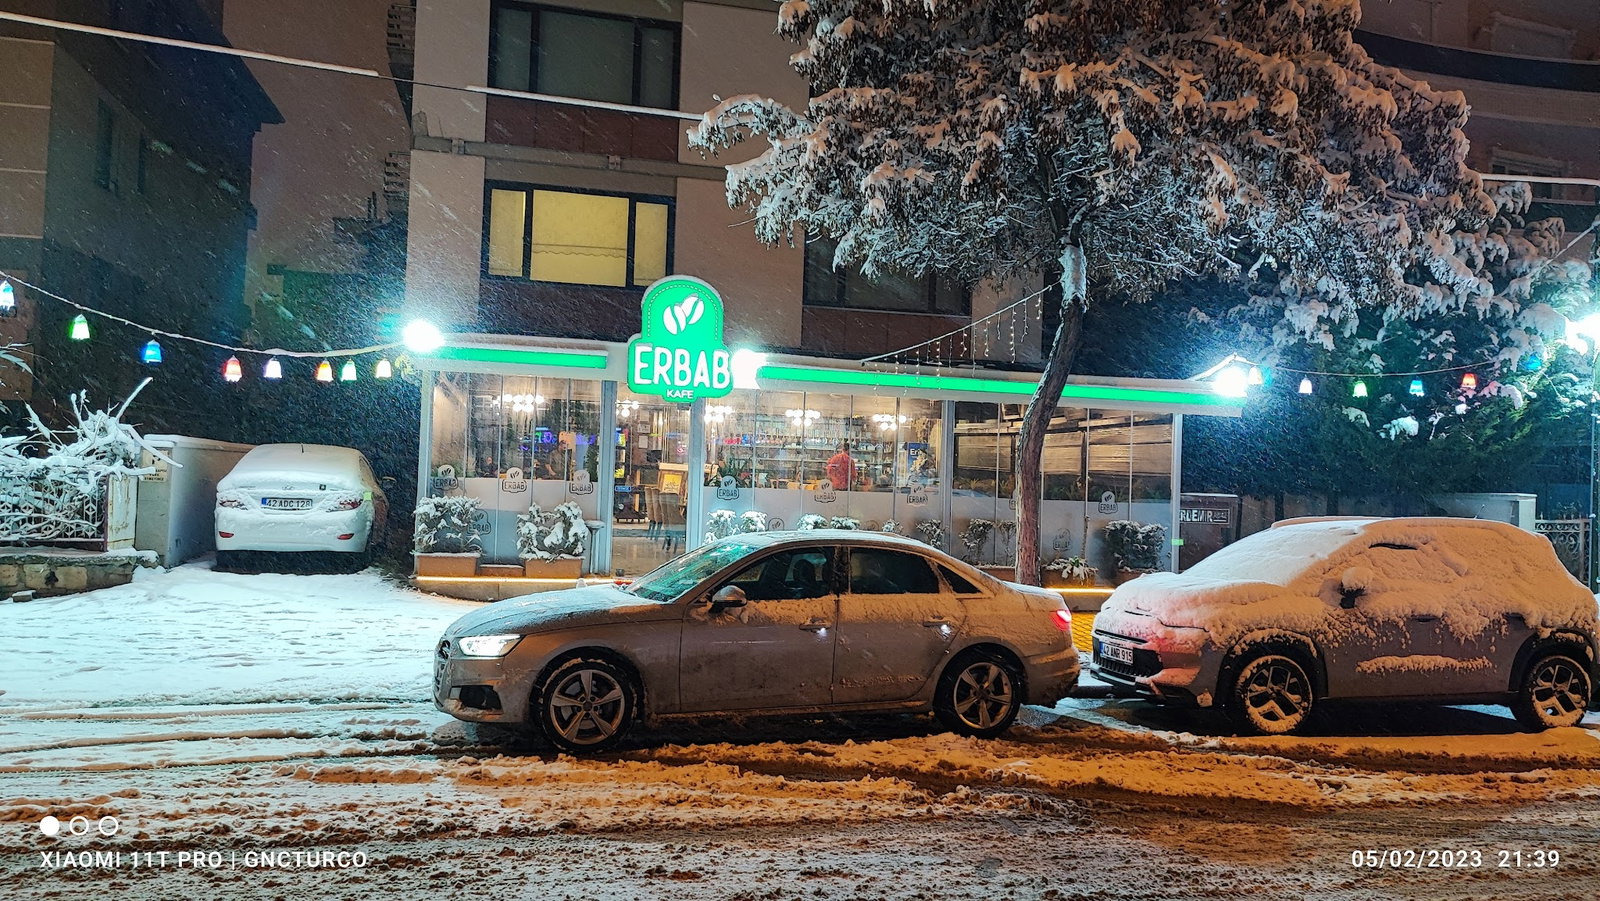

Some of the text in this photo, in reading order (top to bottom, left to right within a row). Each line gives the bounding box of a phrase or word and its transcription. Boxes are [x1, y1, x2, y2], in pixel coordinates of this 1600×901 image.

[634, 343, 731, 389] ERBAB
[666, 389, 694, 399] KAFE
[718, 488, 738, 497] ERBAB
[266, 499, 278, 507] 42
[279, 500, 294, 508] ADC
[1100, 503, 1117, 511] ERBAB
[1103, 645, 1132, 662] 42 ANR 915
